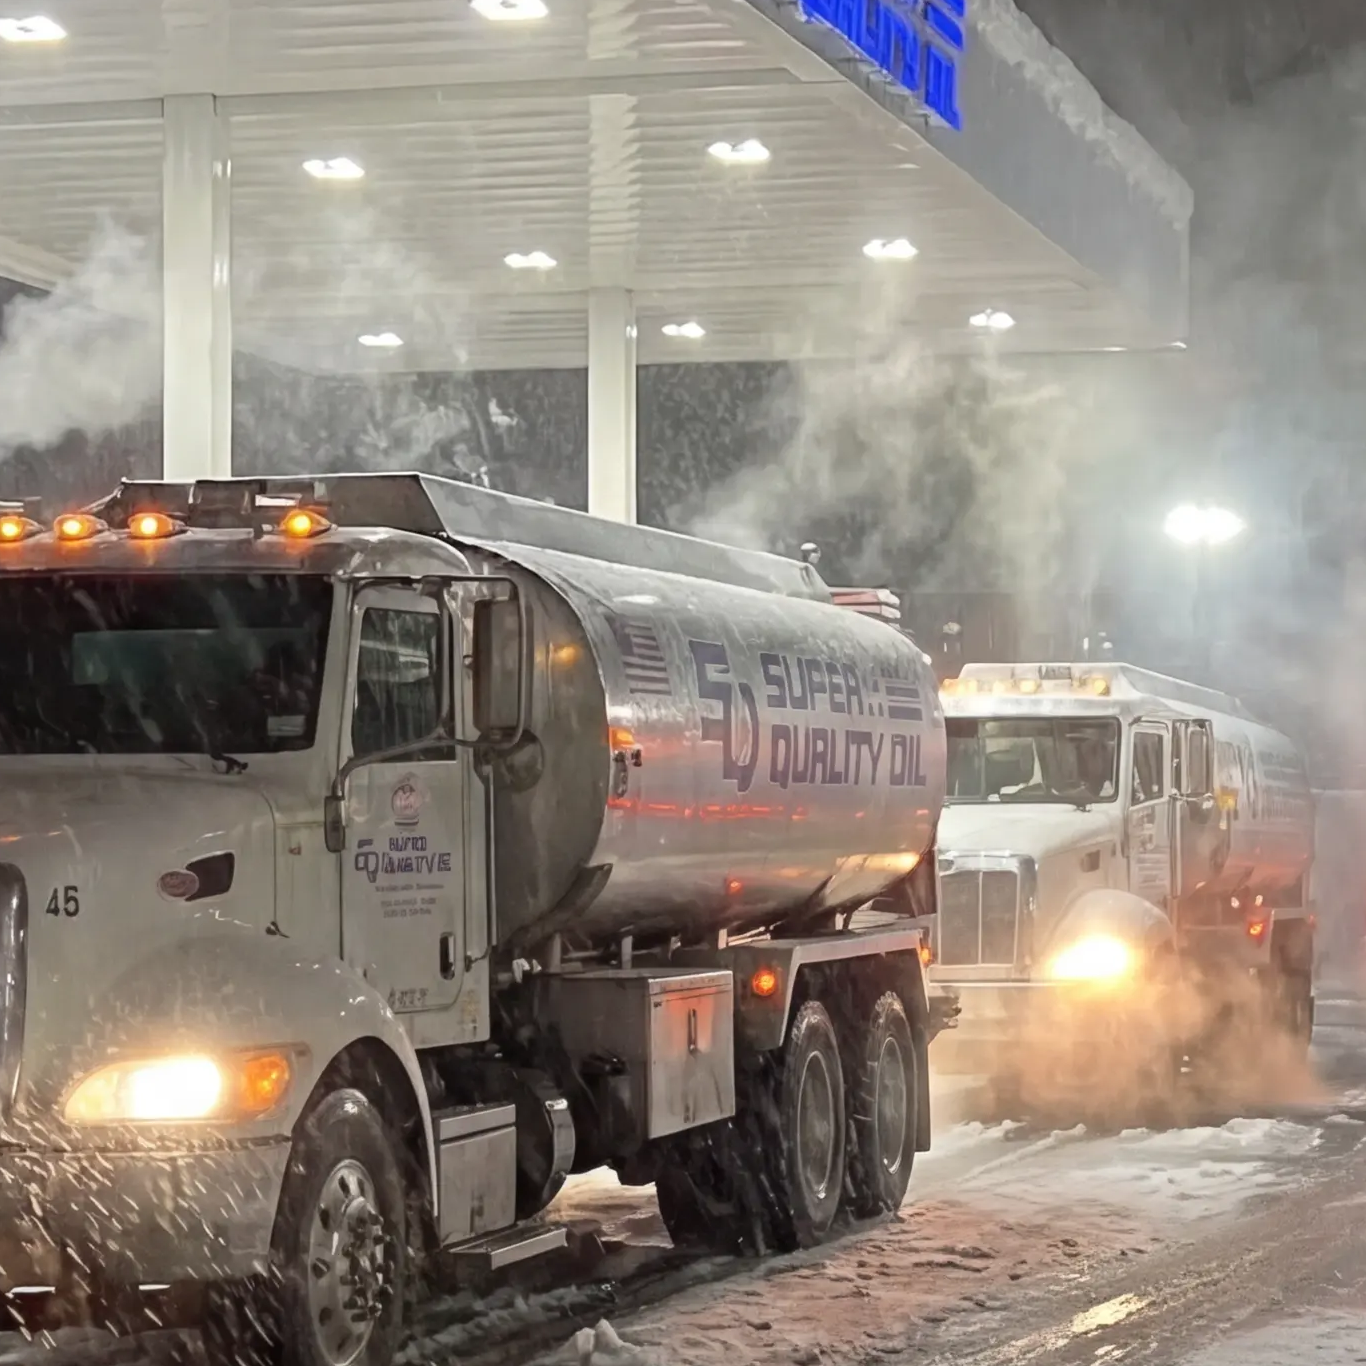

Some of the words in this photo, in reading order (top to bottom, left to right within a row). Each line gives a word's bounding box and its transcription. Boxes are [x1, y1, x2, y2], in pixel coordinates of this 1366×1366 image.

[760, 652, 862, 715] SUPER
[769, 724, 884, 789] QUALITY
[889, 733, 927, 787] OIL
[45, 885, 80, 918] 45
